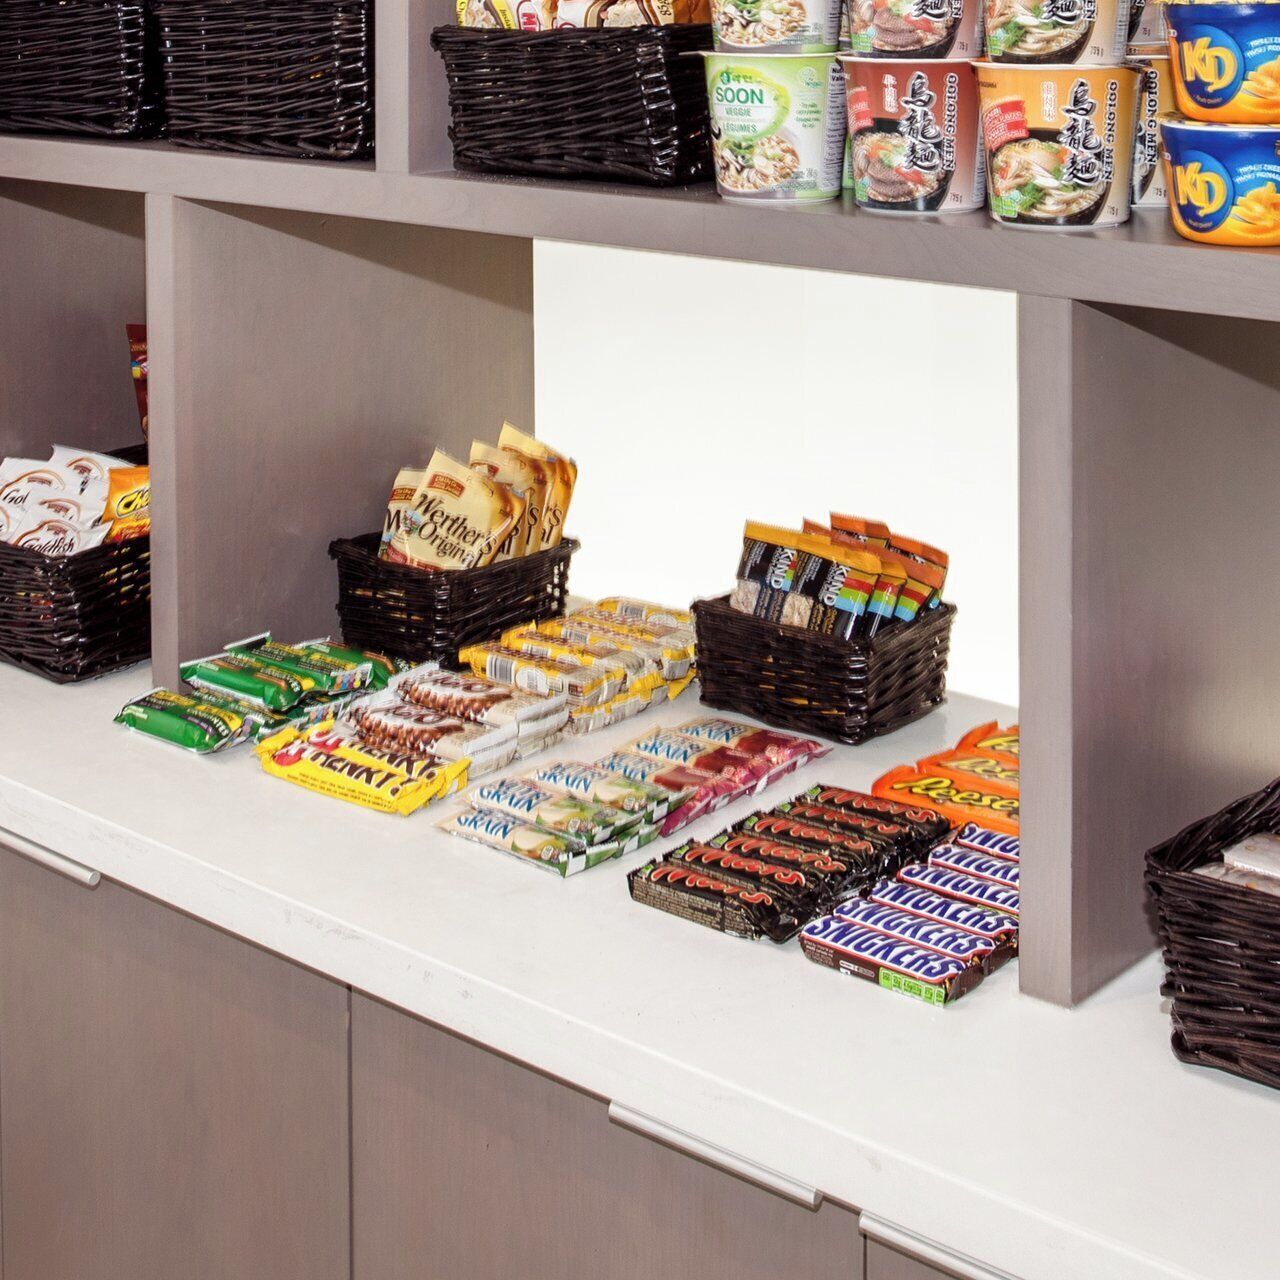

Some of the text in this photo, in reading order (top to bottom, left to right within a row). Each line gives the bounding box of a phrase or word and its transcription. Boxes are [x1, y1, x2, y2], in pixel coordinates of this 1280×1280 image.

[1181, 36, 1238, 94] KD
[716, 86, 764, 104] SOON
[725, 106, 752, 117] VEGGIE
[1144, 69, 1158, 165] OOLONG MEN
[942, 72, 958, 171] OOLONG MEN
[1101, 79, 1120, 183] OOLONG MEN
[1175, 161, 1228, 217] KD
[415, 492, 498, 555] Werther's
[418, 521, 484, 569] Original
[771, 547, 798, 590] KIND
[823, 563, 852, 606] KIND
[635, 740, 690, 764] GRAIN
[479, 786, 542, 813] GRAIN
[536, 769, 592, 794] GRAIN
[892, 776, 1019, 811] Reese
[457, 815, 513, 840] GRAIN
[836, 898, 994, 957] SNICKERS
[872, 880, 1018, 934] SNICKERS
[805, 914, 966, 978] SNICKERS
